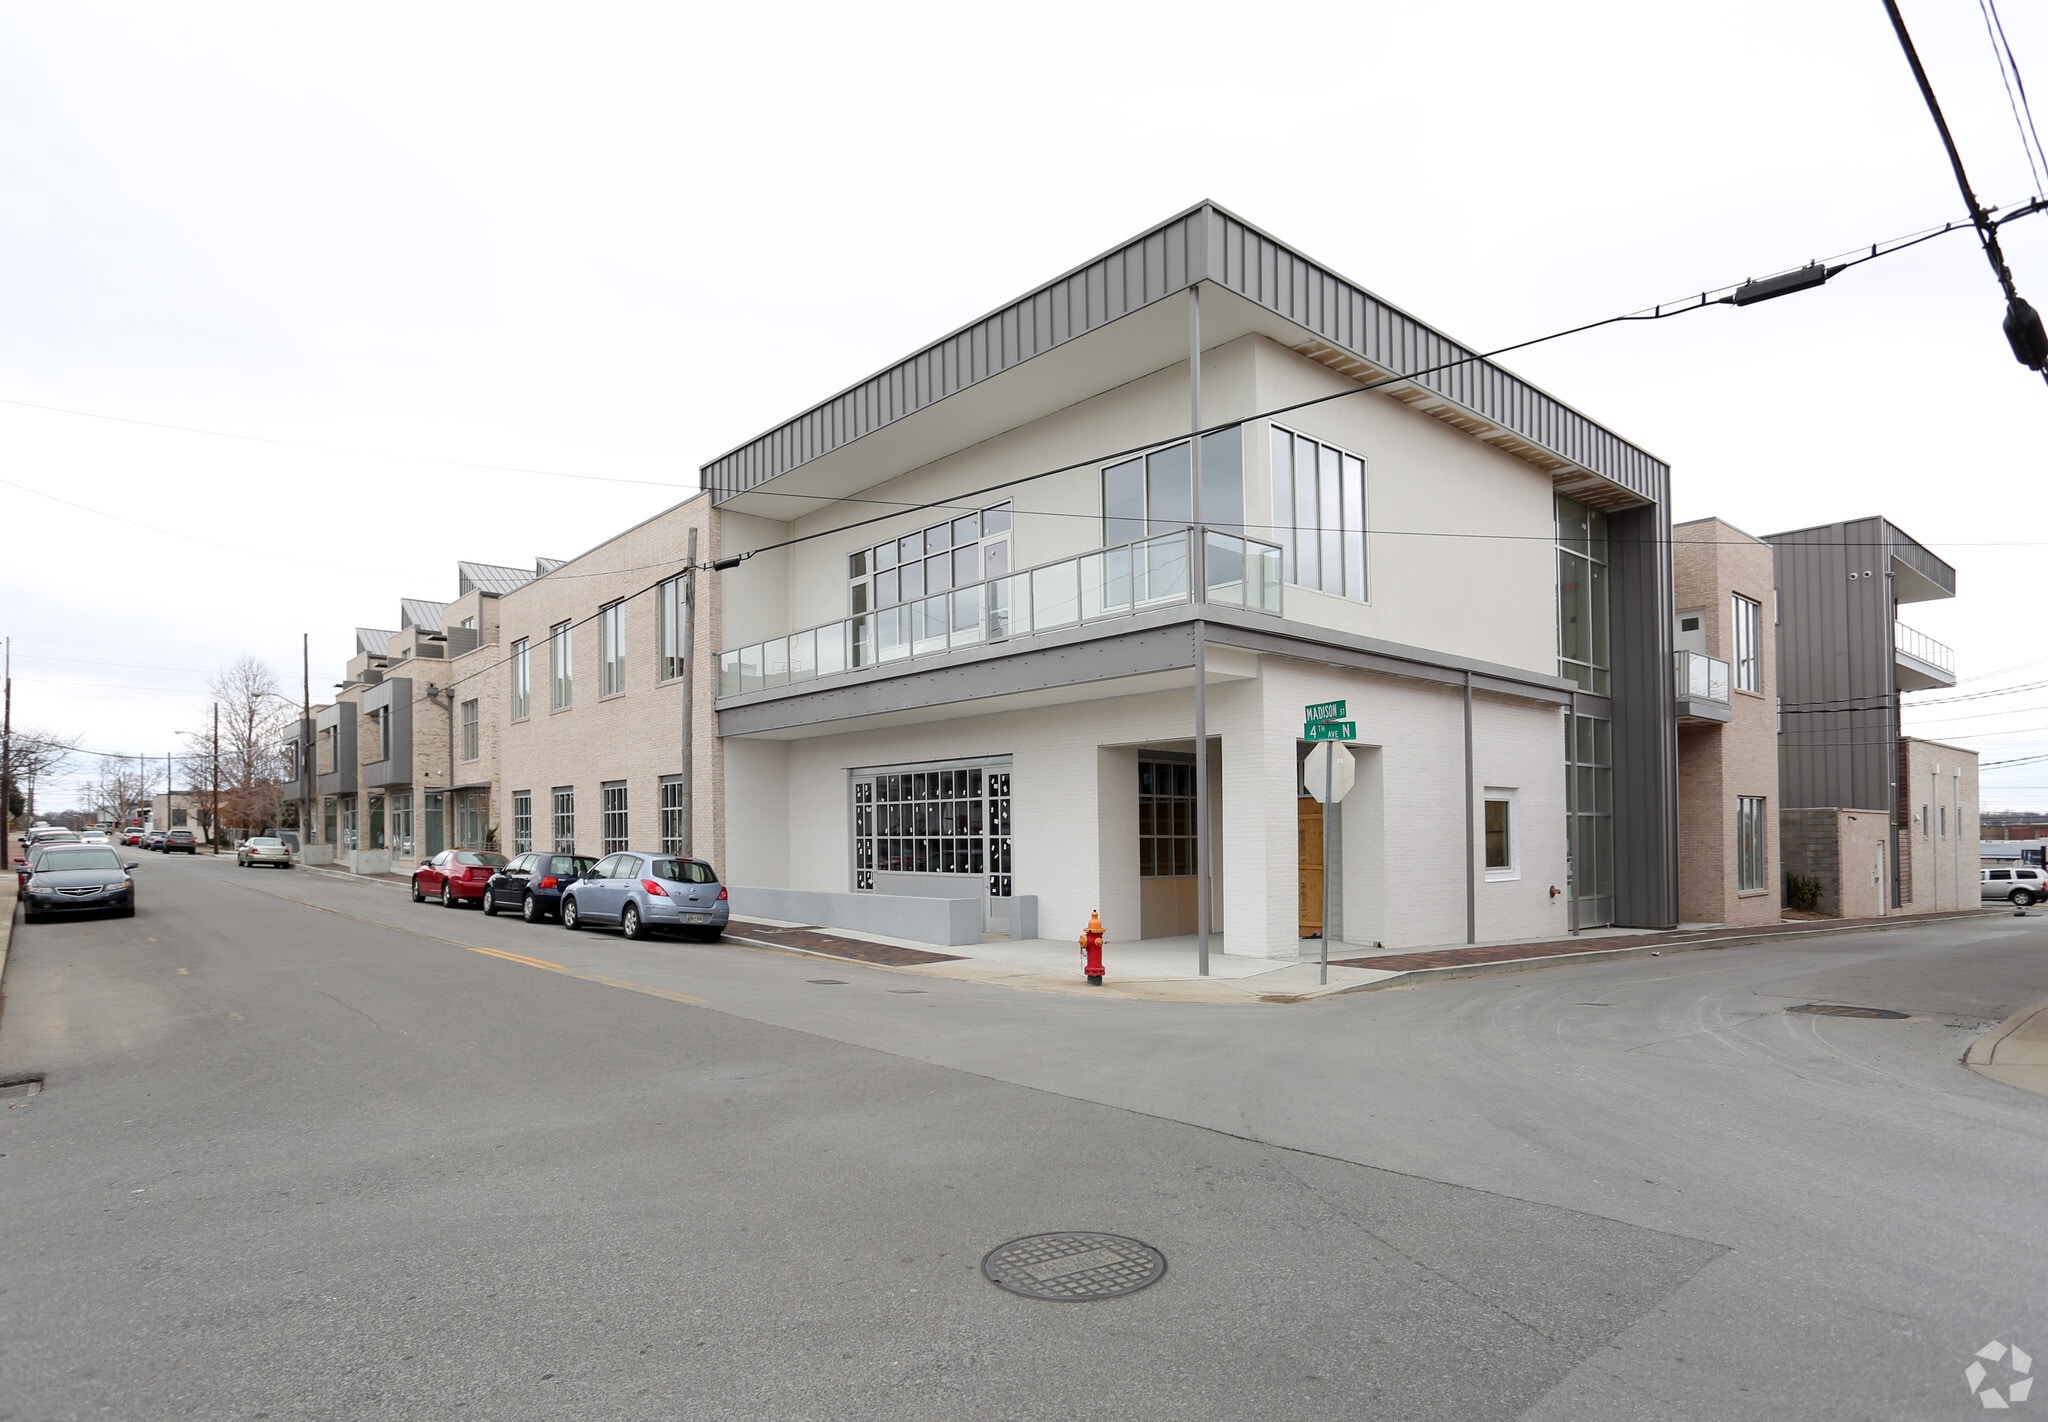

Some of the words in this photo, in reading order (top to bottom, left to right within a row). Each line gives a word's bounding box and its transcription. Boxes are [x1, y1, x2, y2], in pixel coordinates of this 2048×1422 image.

[1306, 704, 1337, 721] MADISON
[1340, 708, 1345, 716] ST
[1310, 725, 1325, 738] 4TH
[1342, 724, 1350, 738] N
